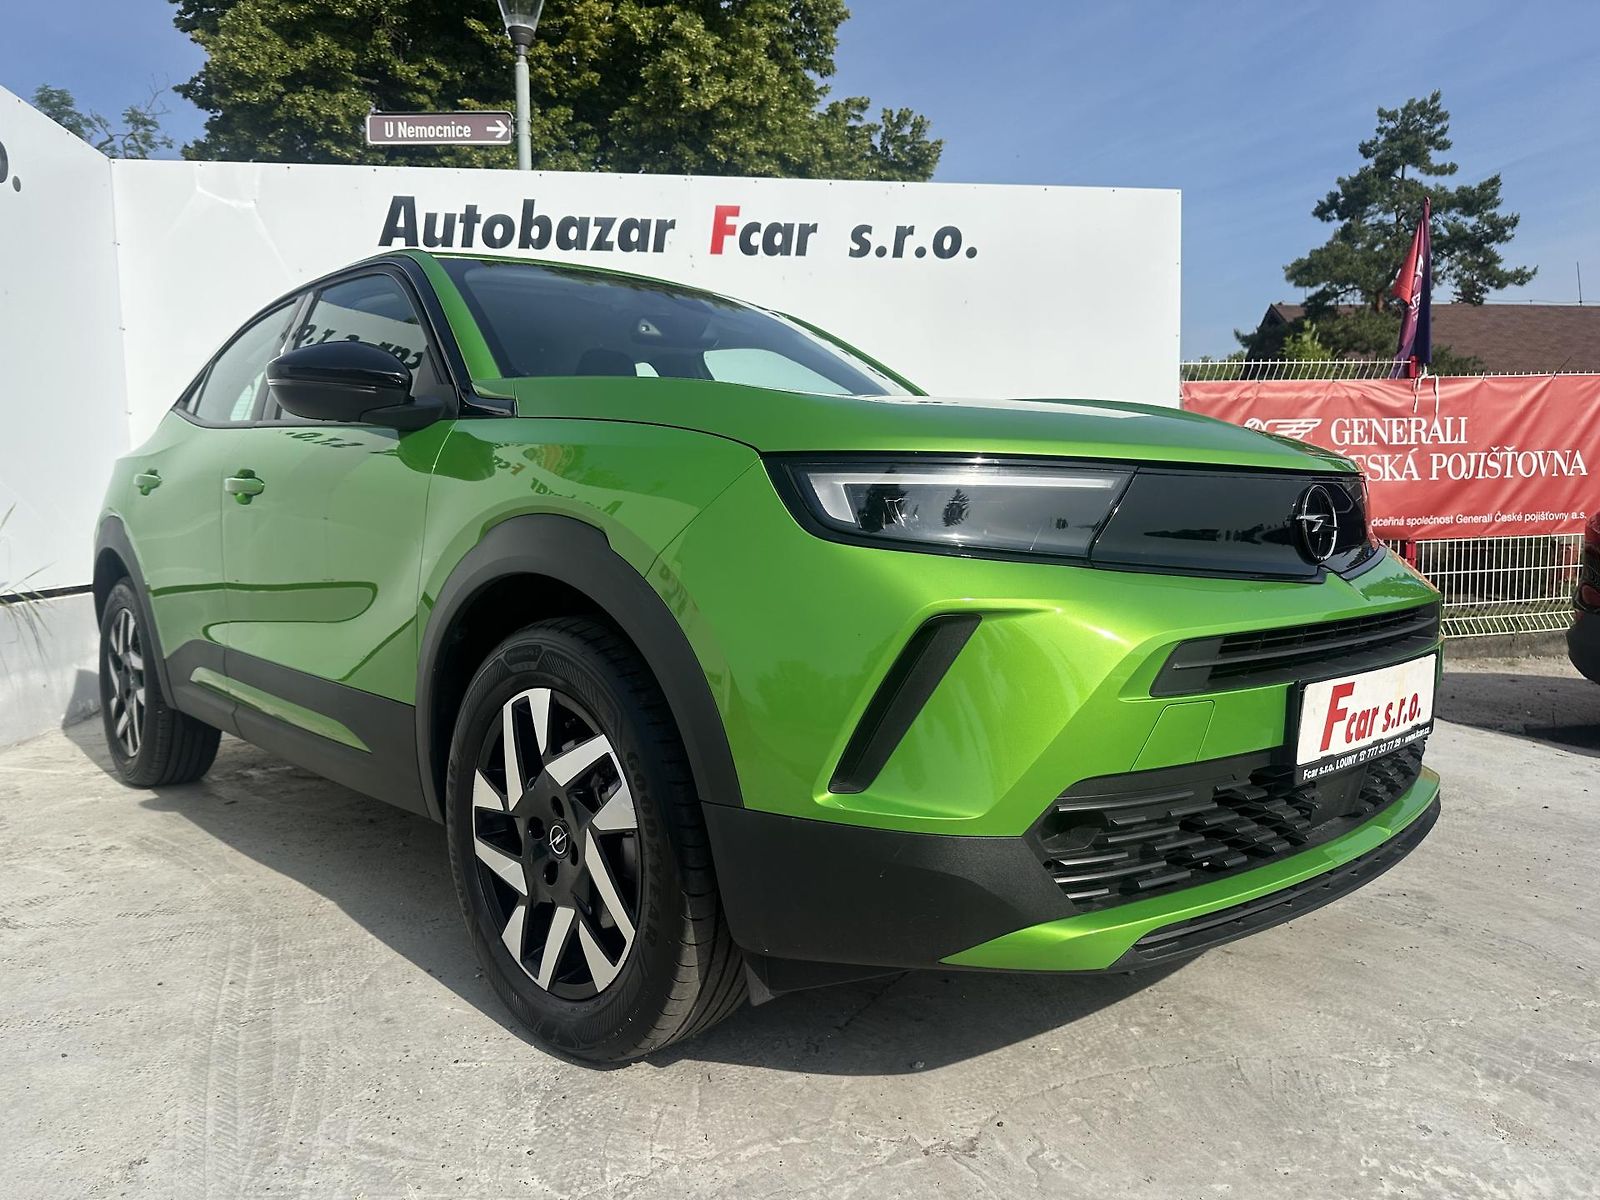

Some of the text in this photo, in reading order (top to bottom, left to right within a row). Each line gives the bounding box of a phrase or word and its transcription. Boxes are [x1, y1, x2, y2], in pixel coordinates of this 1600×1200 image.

[384, 121, 472, 138] U Nemocnice
[378, 195, 978, 260] Autobazar Fcar s.r.o.
[1330, 415, 1468, 447] GENERALI
[1336, 446, 1588, 482] ESKÁ POJIŠŤOVNA
[1406, 513, 1454, 528] společnost
[1455, 512, 1493, 525] Generali
[1494, 510, 1523, 523] České
[1524, 510, 1569, 524] pojišťovny
[1571, 511, 1587, 521] a.s.
[1319, 681, 1421, 752] Fcar s.r.o.
[1303, 766, 1320, 781] Fcar
[1318, 764, 1335, 776] s.r.o.
[1336, 754, 1358, 770] LOUNY
[1367, 745, 1379, 759] 777
[1379, 743, 1387, 754] 33
